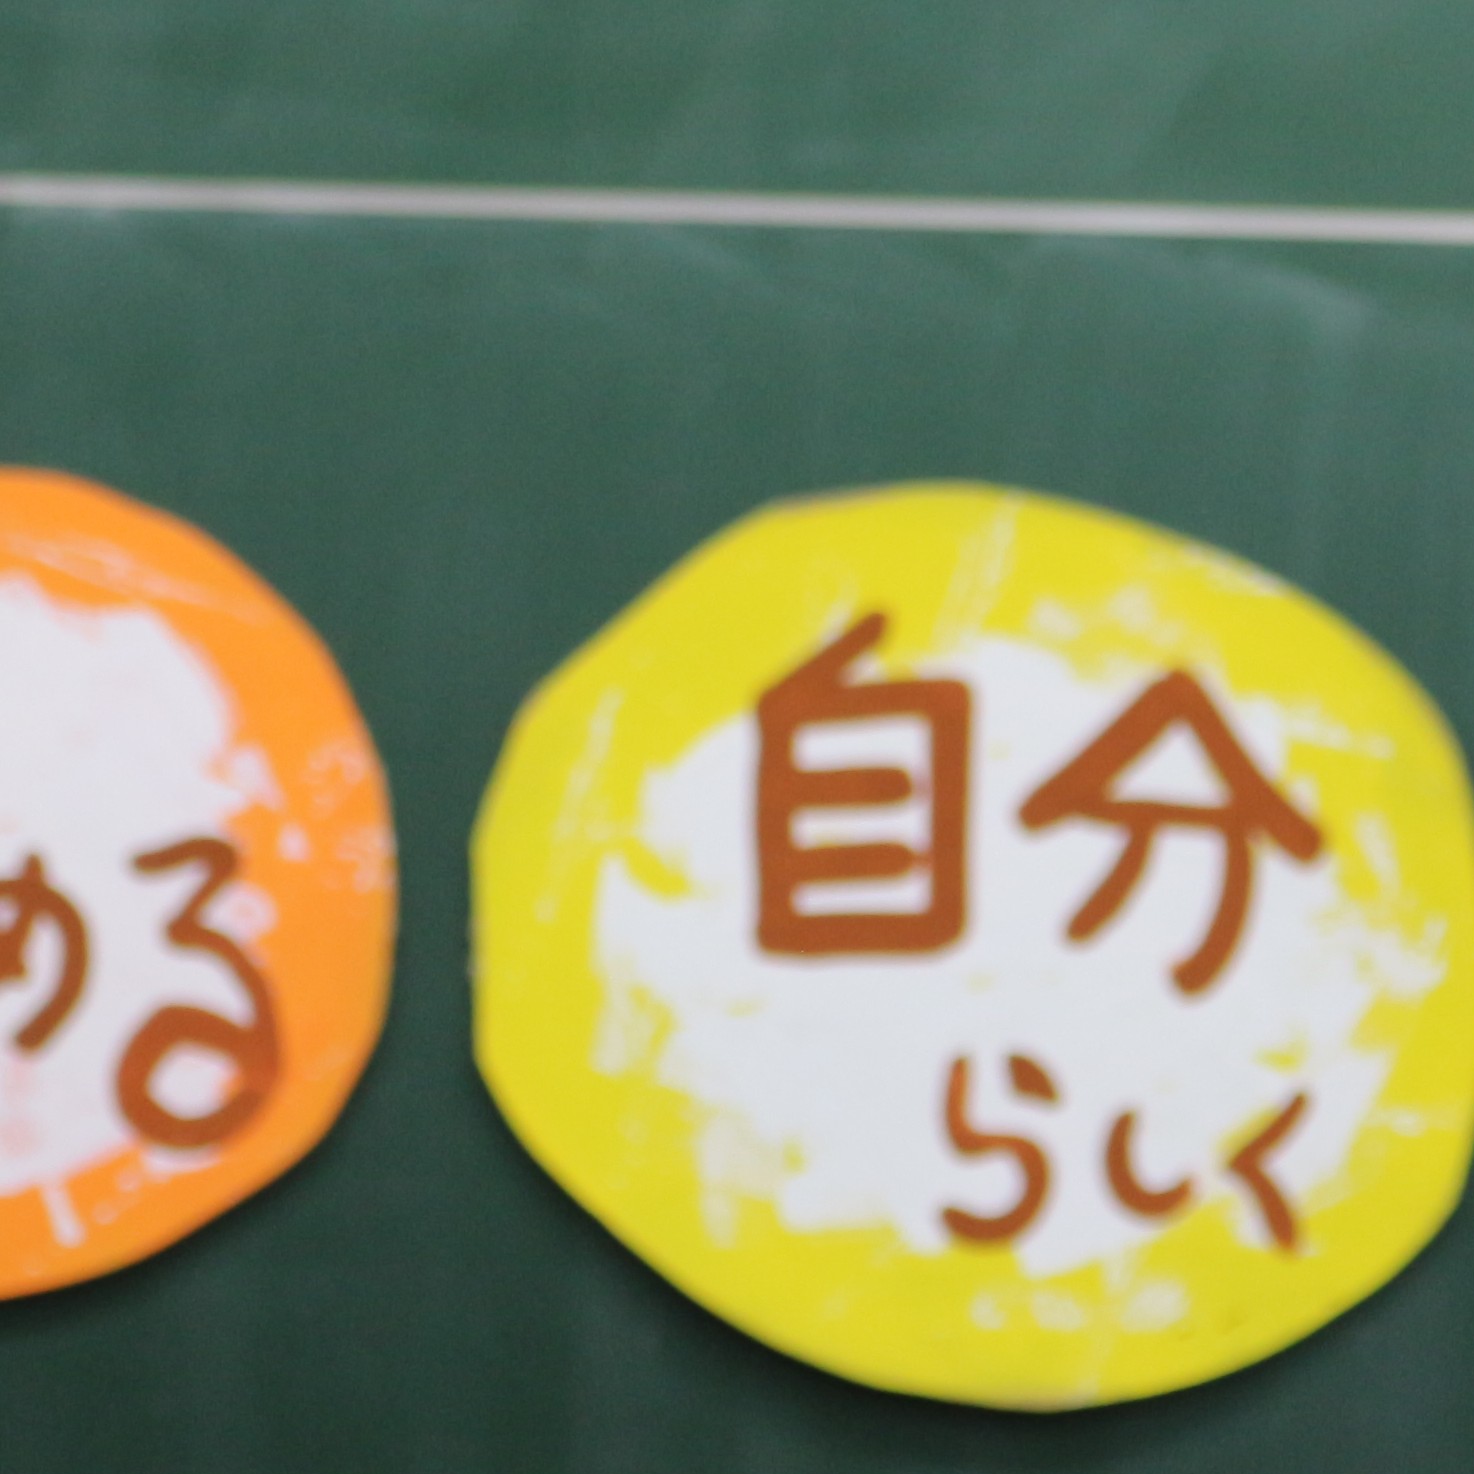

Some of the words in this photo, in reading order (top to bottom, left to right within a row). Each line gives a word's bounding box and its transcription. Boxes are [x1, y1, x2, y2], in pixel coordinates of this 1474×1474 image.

[756, 612, 1324, 996] 自分
[941, 1053, 1308, 1257] らしく
